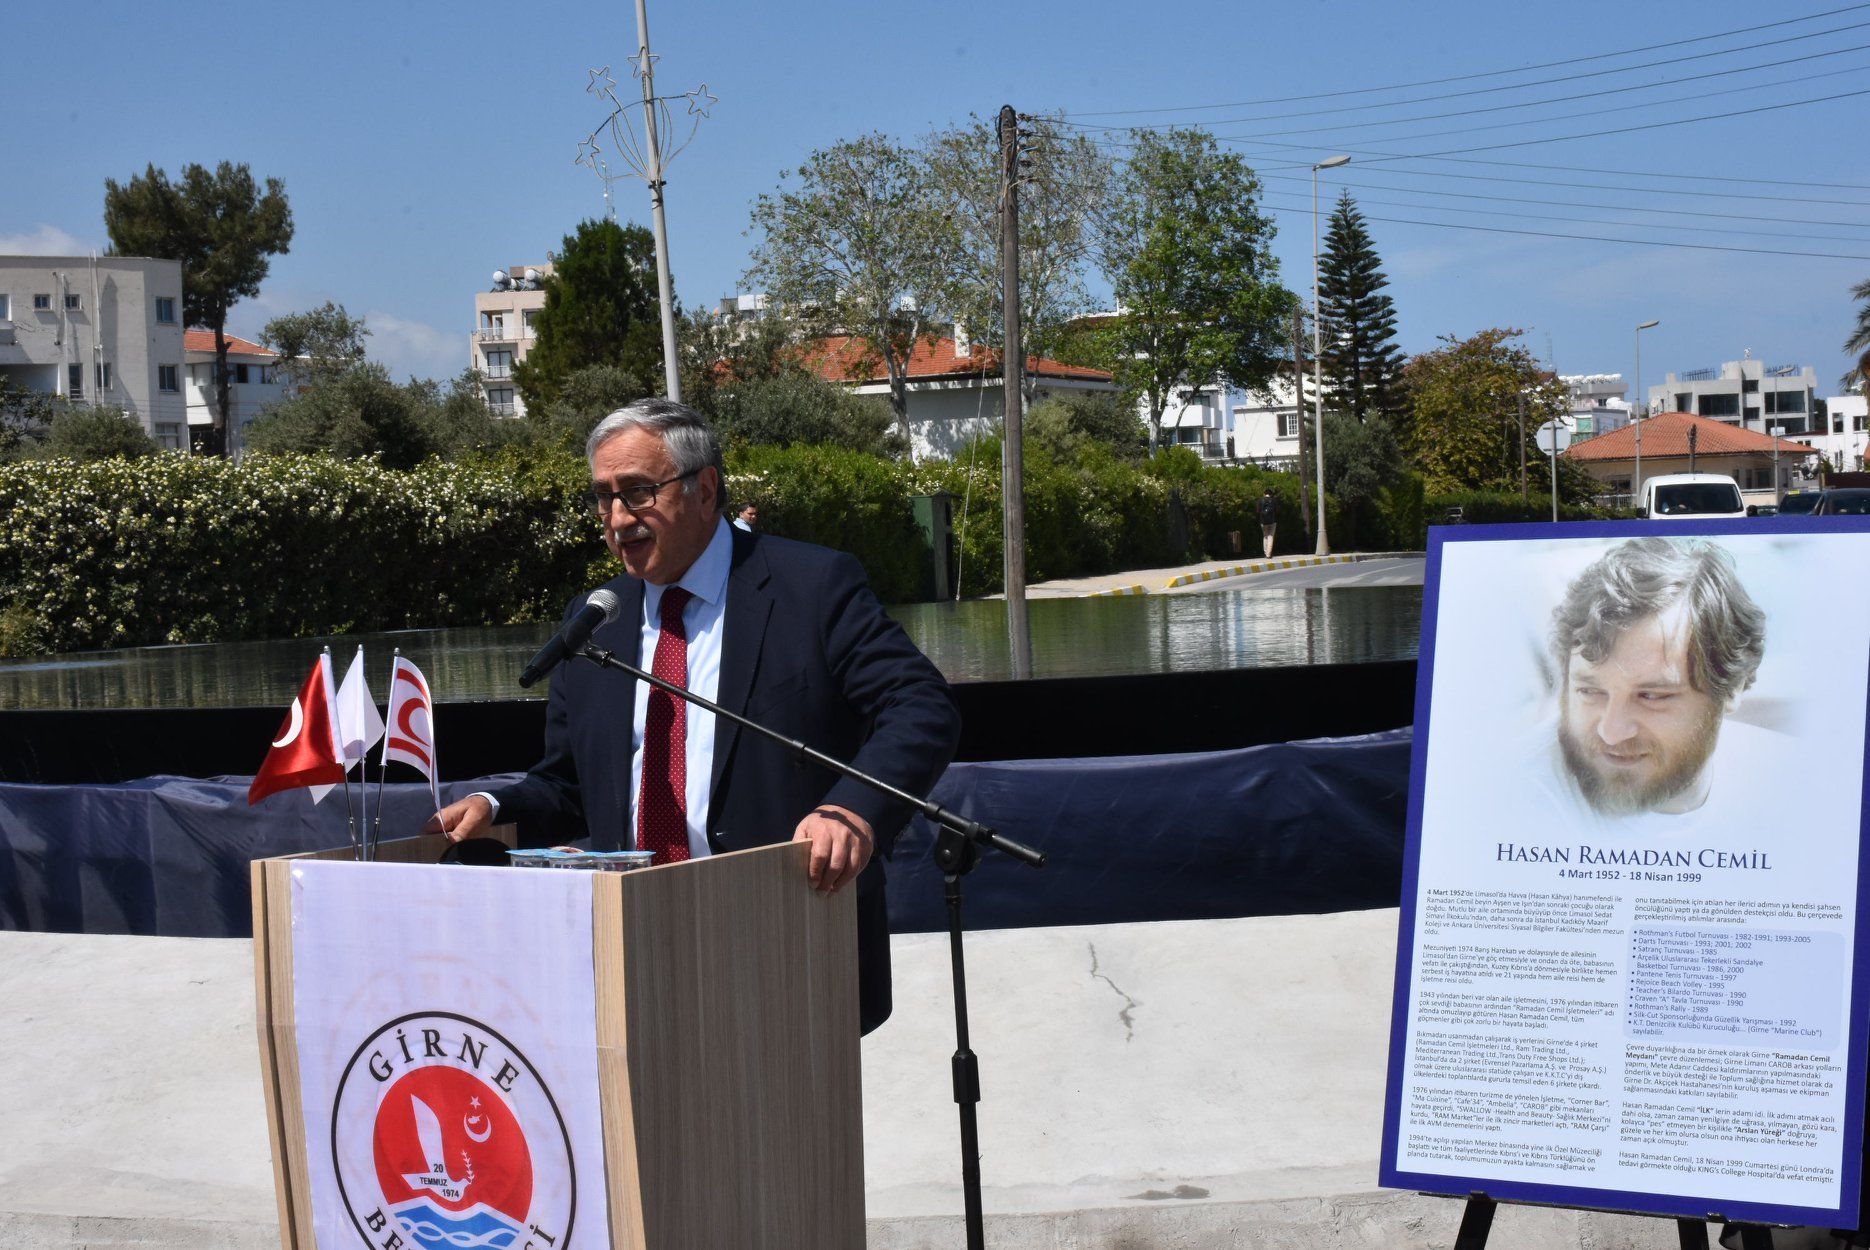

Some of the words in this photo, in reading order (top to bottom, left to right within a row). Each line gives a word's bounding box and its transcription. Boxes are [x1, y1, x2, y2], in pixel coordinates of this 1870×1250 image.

[1559, 869, 1565, 878] 4
[1568, 869, 1593, 879] Mart
[1596, 870, 1620, 880] 1952
[1630, 871, 1642, 881] 18
[1645, 871, 1673, 882] Nisan
[1677, 872, 1702, 883] 1999
[1634, 905, 1673, 913] öncülüğünü
[1743, 909, 1777, 917] destekçisi
[1807, 911, 1843, 920] çerçevede
[1638, 945, 1662, 954] Satranç
[1637, 953, 1659, 962] Arçelik
[1733, 958, 1764, 967] Sandalye
[1636, 978, 1660, 986] Rejoice
[1692, 989, 1724, 997] Turnuvası
[368, 1028, 520, 1093] GİRNE
[1621, 1118, 1645, 1127] kolayca
[1499, 1141, 1530, 1150] binasında
[1570, 1147, 1602, 1157] Müzeciliği
[433, 1163, 444, 1173] 20
[1640, 1153, 1672, 1161] Ramadan
[1744, 1161, 1779, 1170] Cumartesi
[1780, 1164, 1798, 1172] günü
[420, 1176, 448, 1187] TEMMUZ
[442, 1189, 460, 1198] 1974
